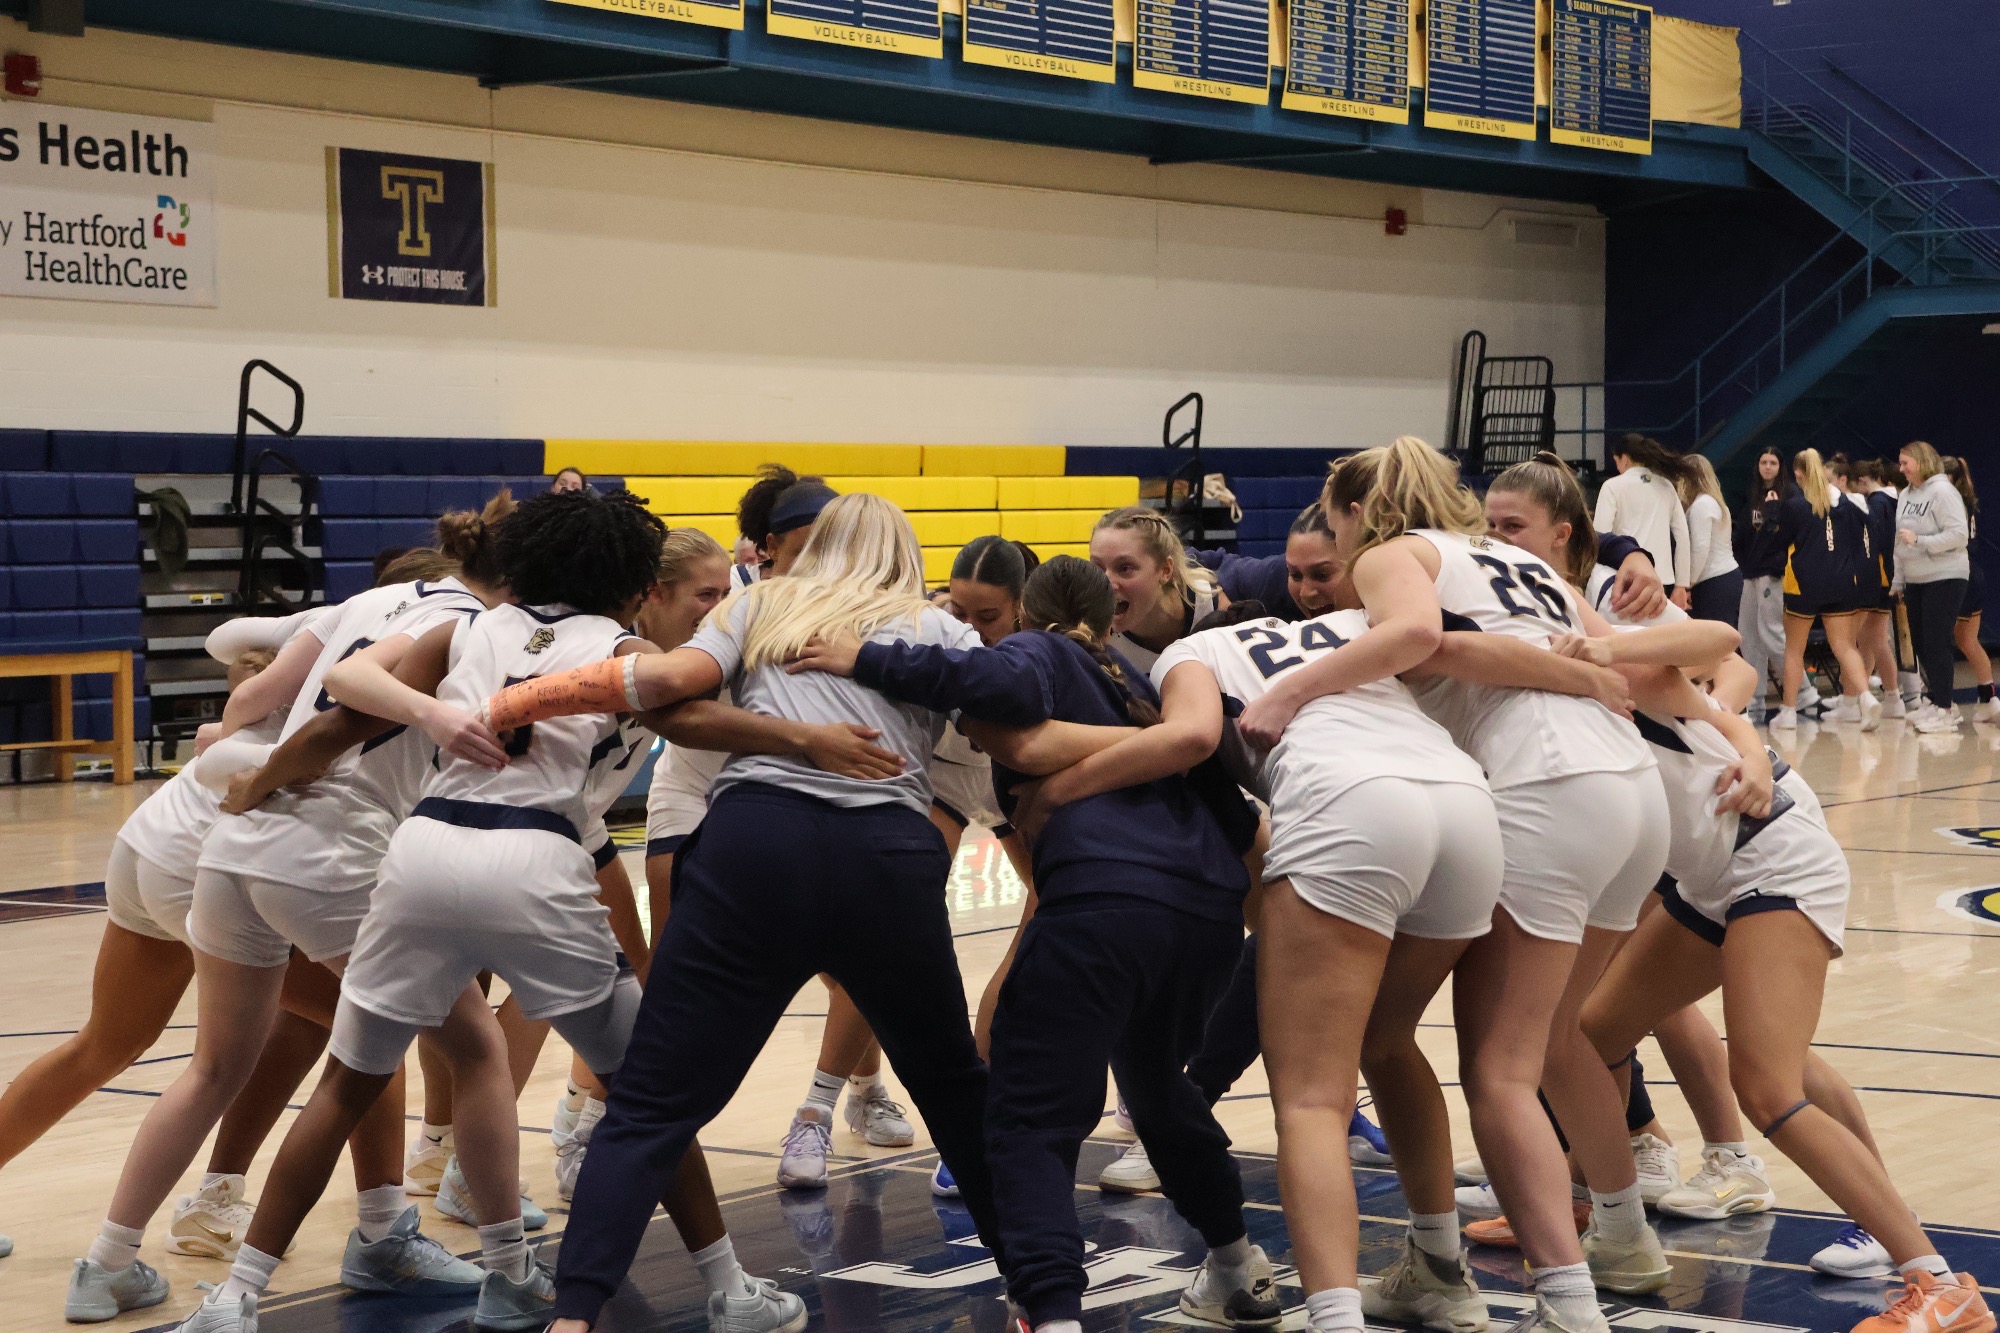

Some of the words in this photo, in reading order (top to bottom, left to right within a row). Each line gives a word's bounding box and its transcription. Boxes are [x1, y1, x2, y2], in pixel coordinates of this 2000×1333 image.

[604, 0, 693, 18] OLLEYBALL
[813, 25, 898, 48] VOLLEYBALL
[1005, 54, 1077, 73] VOLLEYBALL
[1173, 80, 1232, 97] WRESTLING
[1321, 101, 1375, 117] WRESTLING
[1457, 118, 1507, 133] WRESTLING
[38, 122, 188, 178] Health
[1580, 136, 1624, 149] WRESTLING
[380, 165, 445, 257] T
[23, 211, 147, 250] Hartford
[25, 251, 188, 290] HealthCare
[387, 265, 420, 288] PROTECT
[422, 268, 440, 289] THIS
[1469, 552, 1573, 630] 26
[1235, 621, 1350, 681] 24
